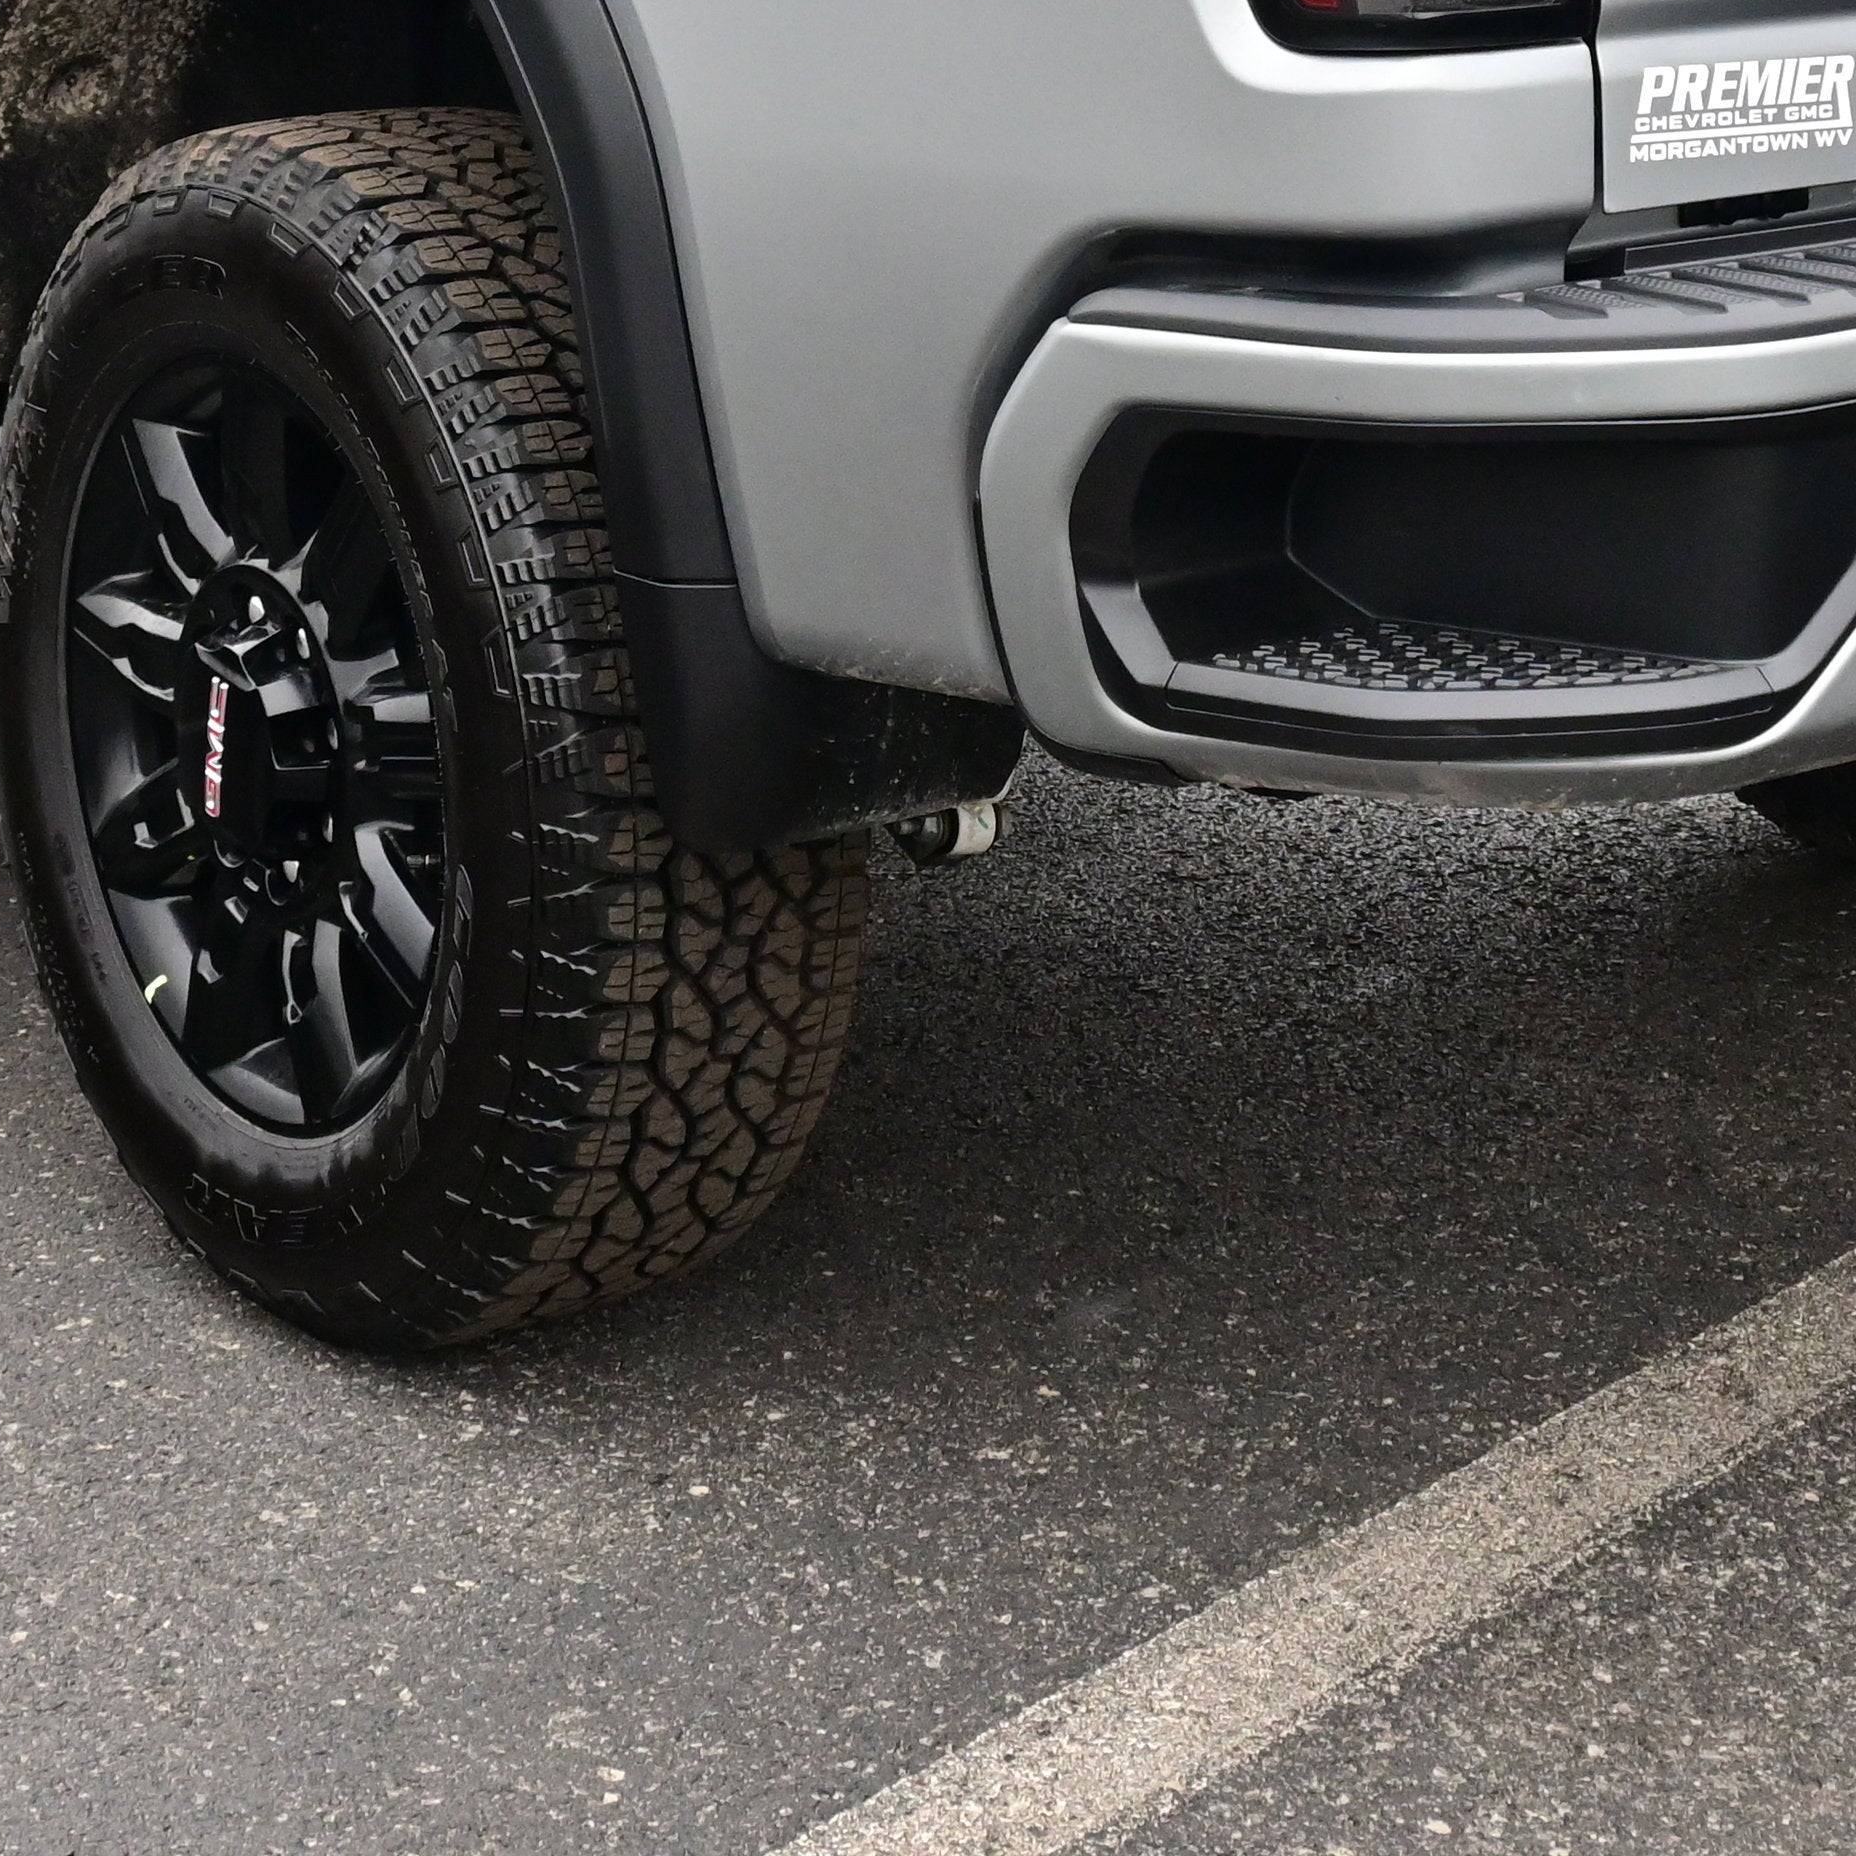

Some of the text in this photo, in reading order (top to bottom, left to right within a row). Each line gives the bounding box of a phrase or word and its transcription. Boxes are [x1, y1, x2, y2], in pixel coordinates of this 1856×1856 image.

[1637, 55, 1855, 117] PREMIER
[1634, 103, 1834, 132] CHEVROLET GMC
[1629, 128, 1854, 163] MORGANTOWN WV
